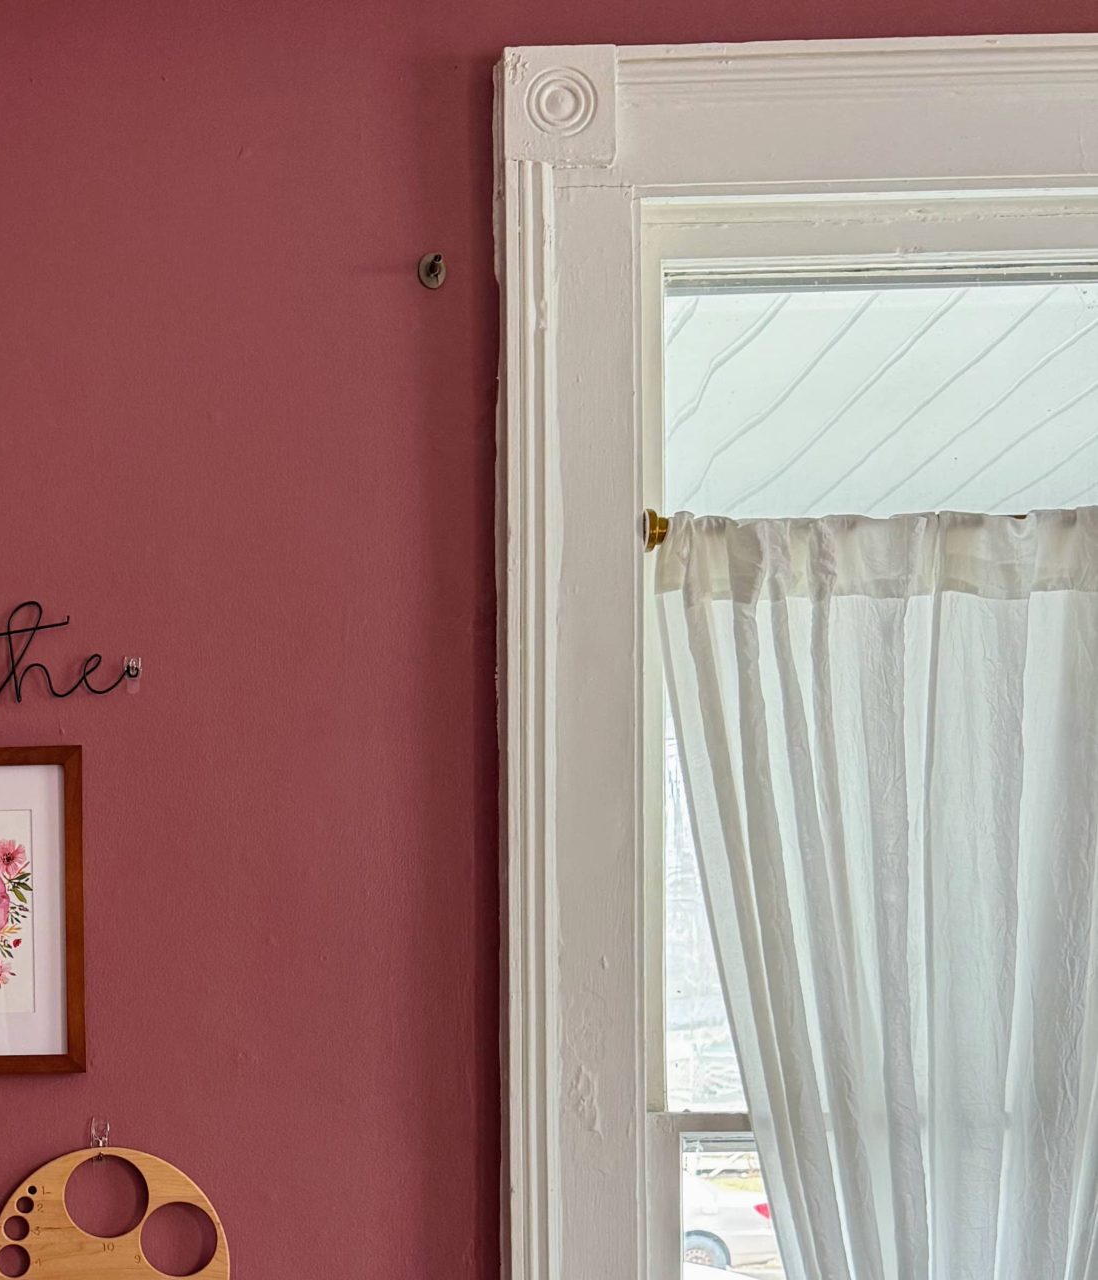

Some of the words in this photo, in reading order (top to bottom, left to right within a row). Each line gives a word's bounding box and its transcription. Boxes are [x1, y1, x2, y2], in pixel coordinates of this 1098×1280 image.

[37, 1203, 44, 1213] 2
[102, 1242, 115, 1252] 10
[134, 1254, 141, 1264] 9
